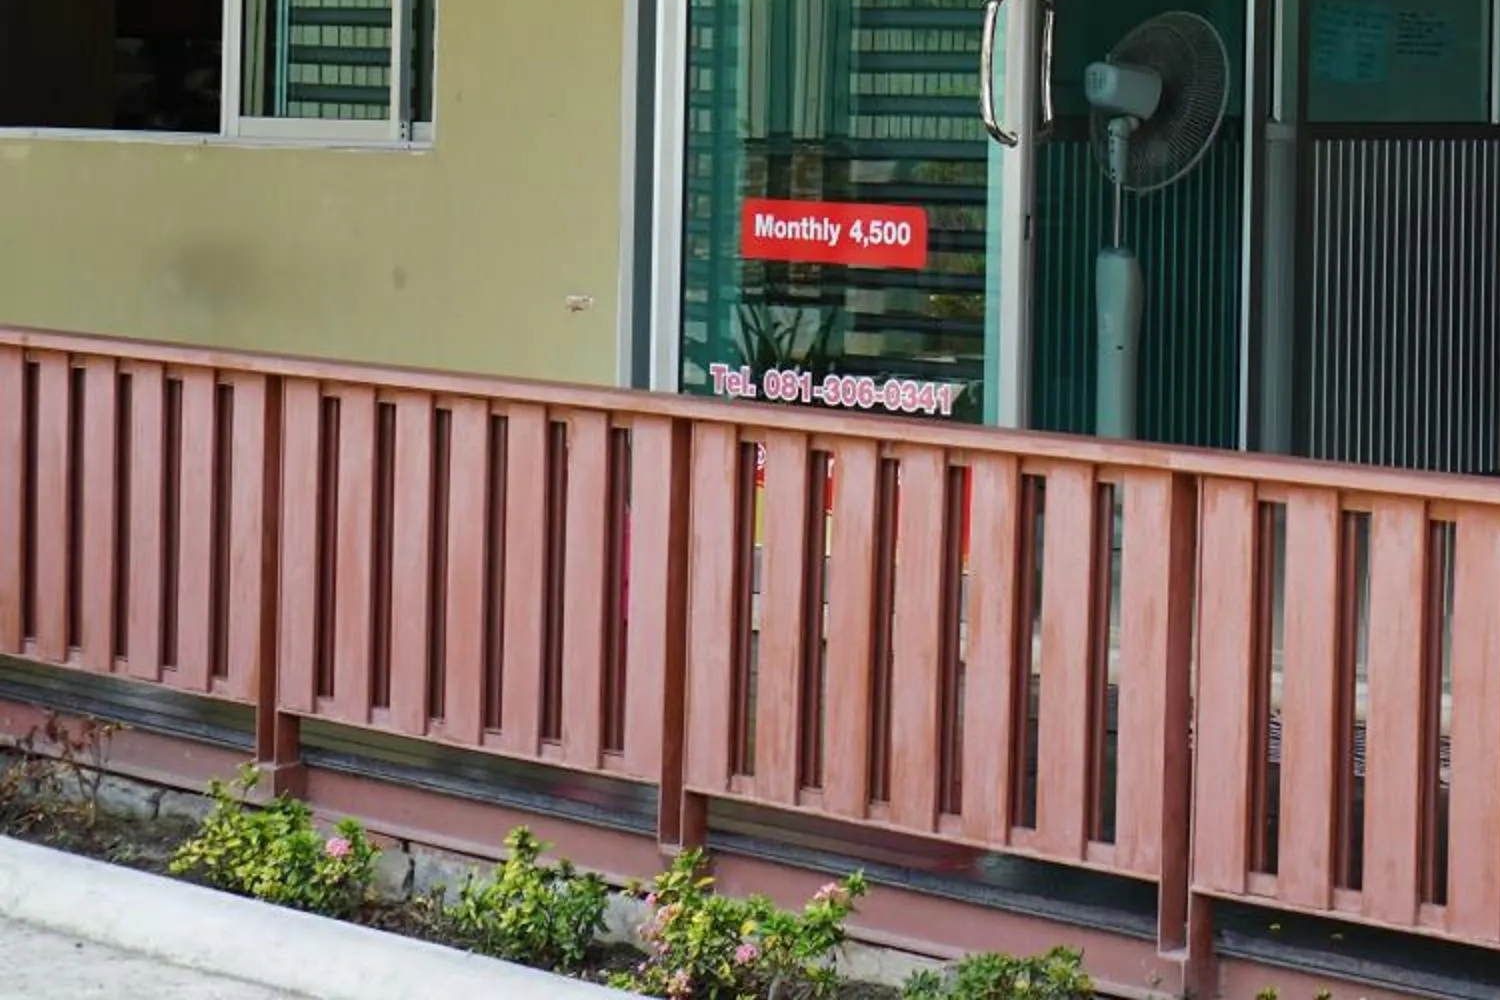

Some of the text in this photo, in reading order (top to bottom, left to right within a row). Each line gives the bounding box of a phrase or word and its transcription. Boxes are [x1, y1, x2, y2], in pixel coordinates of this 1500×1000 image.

[755, 213, 911, 248] Monthly 4,500
[710, 364, 954, 414] Tel. 081-306-0341
